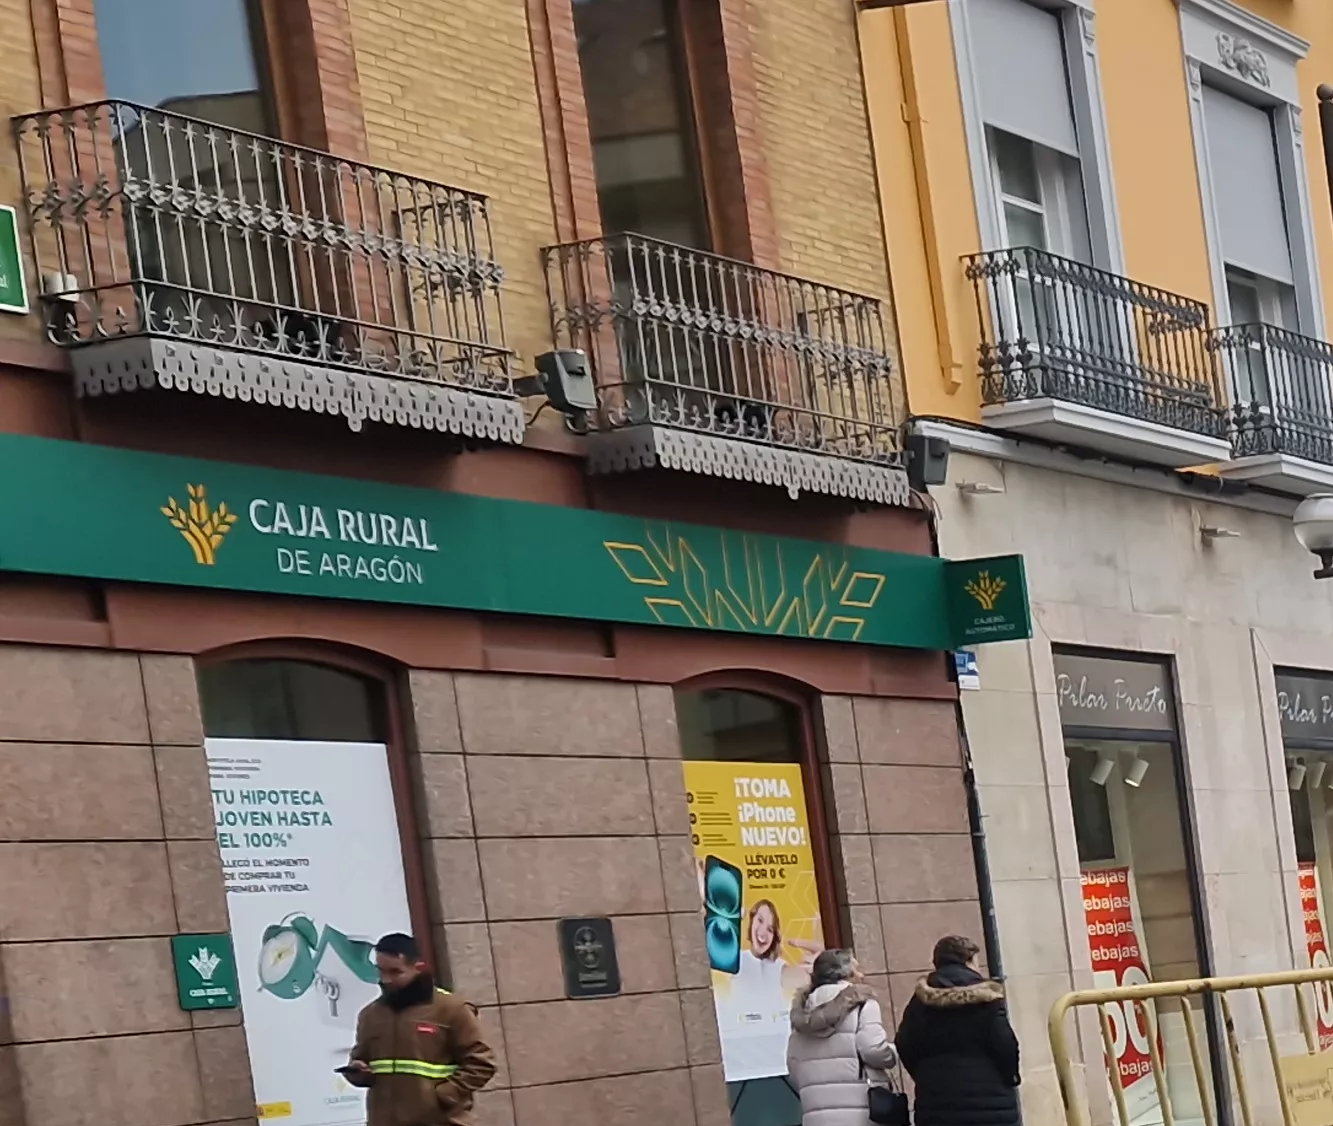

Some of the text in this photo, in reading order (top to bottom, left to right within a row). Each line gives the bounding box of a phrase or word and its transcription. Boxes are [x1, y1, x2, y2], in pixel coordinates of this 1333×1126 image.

[249, 498, 439, 551] CAJA RURAL
[277, 548, 424, 585] DE ARAGÓN
[1056, 672, 1167, 715] Pilar Prieto
[211, 789, 325, 806] TU HIPOTECA
[216, 810, 333, 827] JOVEN HASTA
[738, 801, 796, 823] iPhone
[218, 832, 240, 849] EL
[741, 826, 806, 847] NUEVO!
[746, 868, 768, 879] POR
[1080, 871, 1127, 888] ebajas
[1083, 893, 1131, 911] ebajas
[1088, 917, 1135, 937] ebajas
[1091, 943, 1140, 962] ebajas
